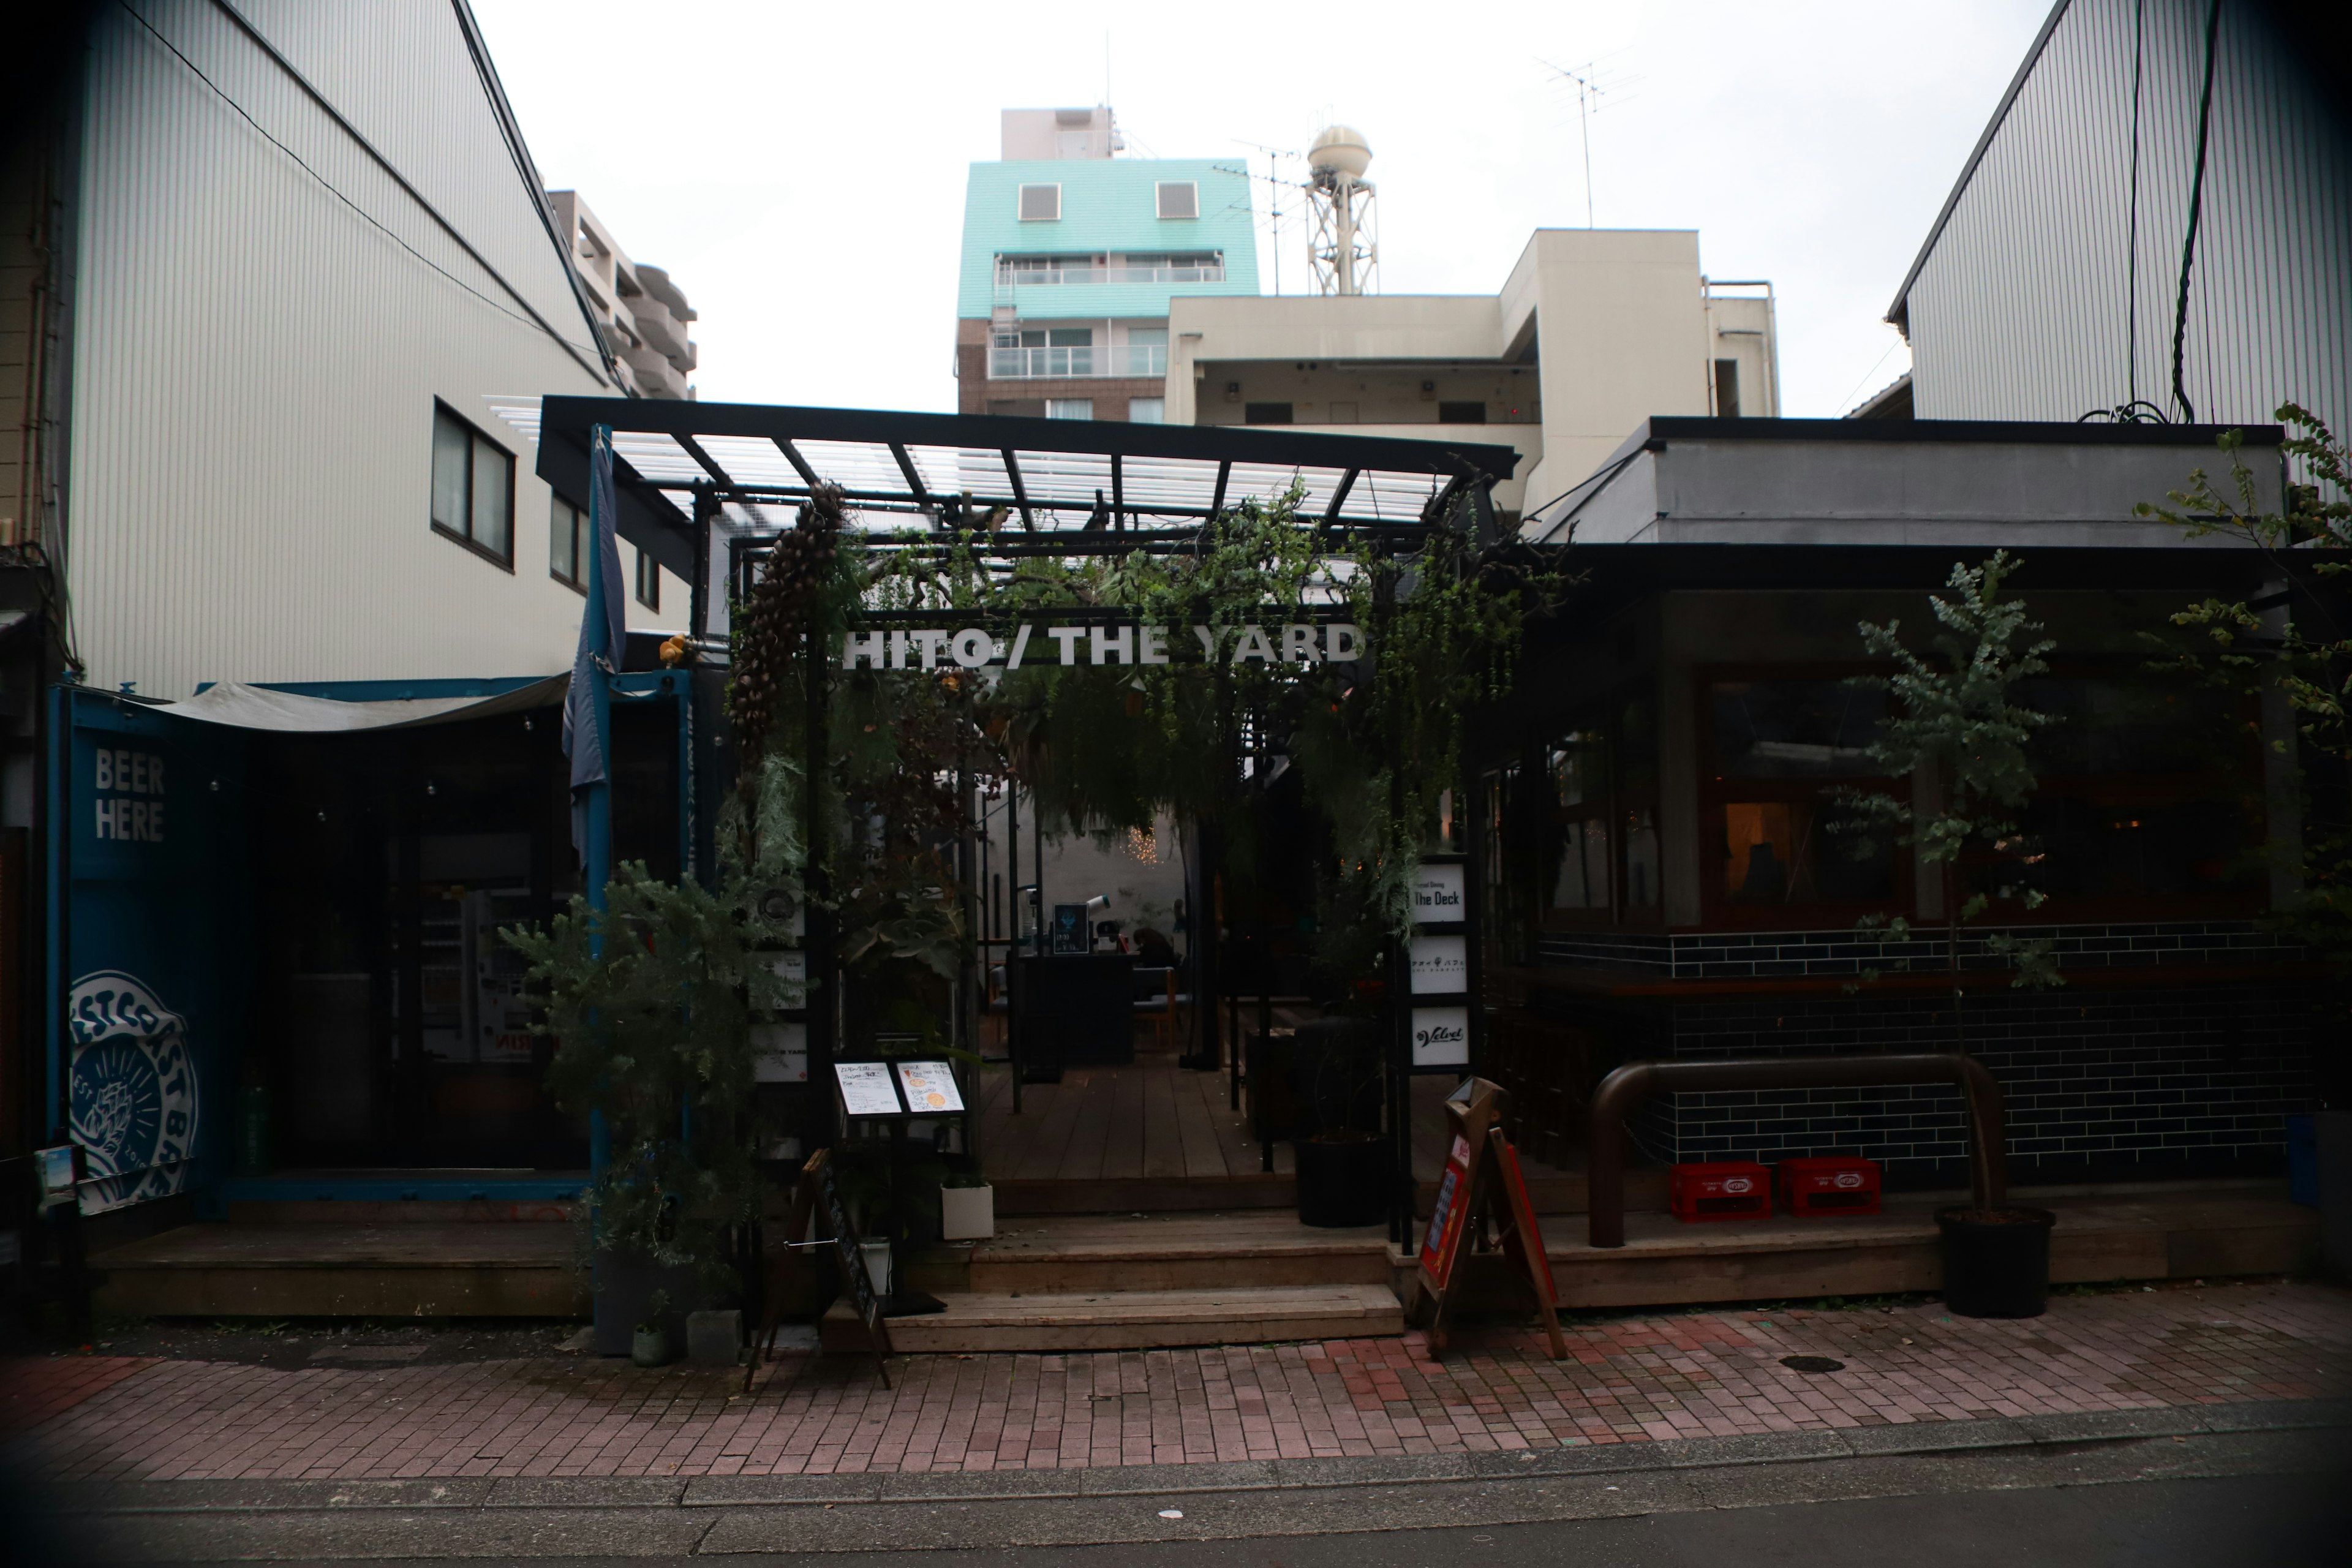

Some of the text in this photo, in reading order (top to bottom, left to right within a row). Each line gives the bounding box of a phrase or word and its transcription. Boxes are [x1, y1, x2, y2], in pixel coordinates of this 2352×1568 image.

[842, 628, 993, 669] HITO
[1048, 625, 1170, 666] THE
[1193, 623, 1366, 664] YARD
[96, 748, 165, 794] BEER
[96, 798, 165, 842] HERE
[1415, 891, 1460, 905] The Deck
[117, 992, 186, 1097] COAST
[1420, 1026, 1464, 1048] Velvet
